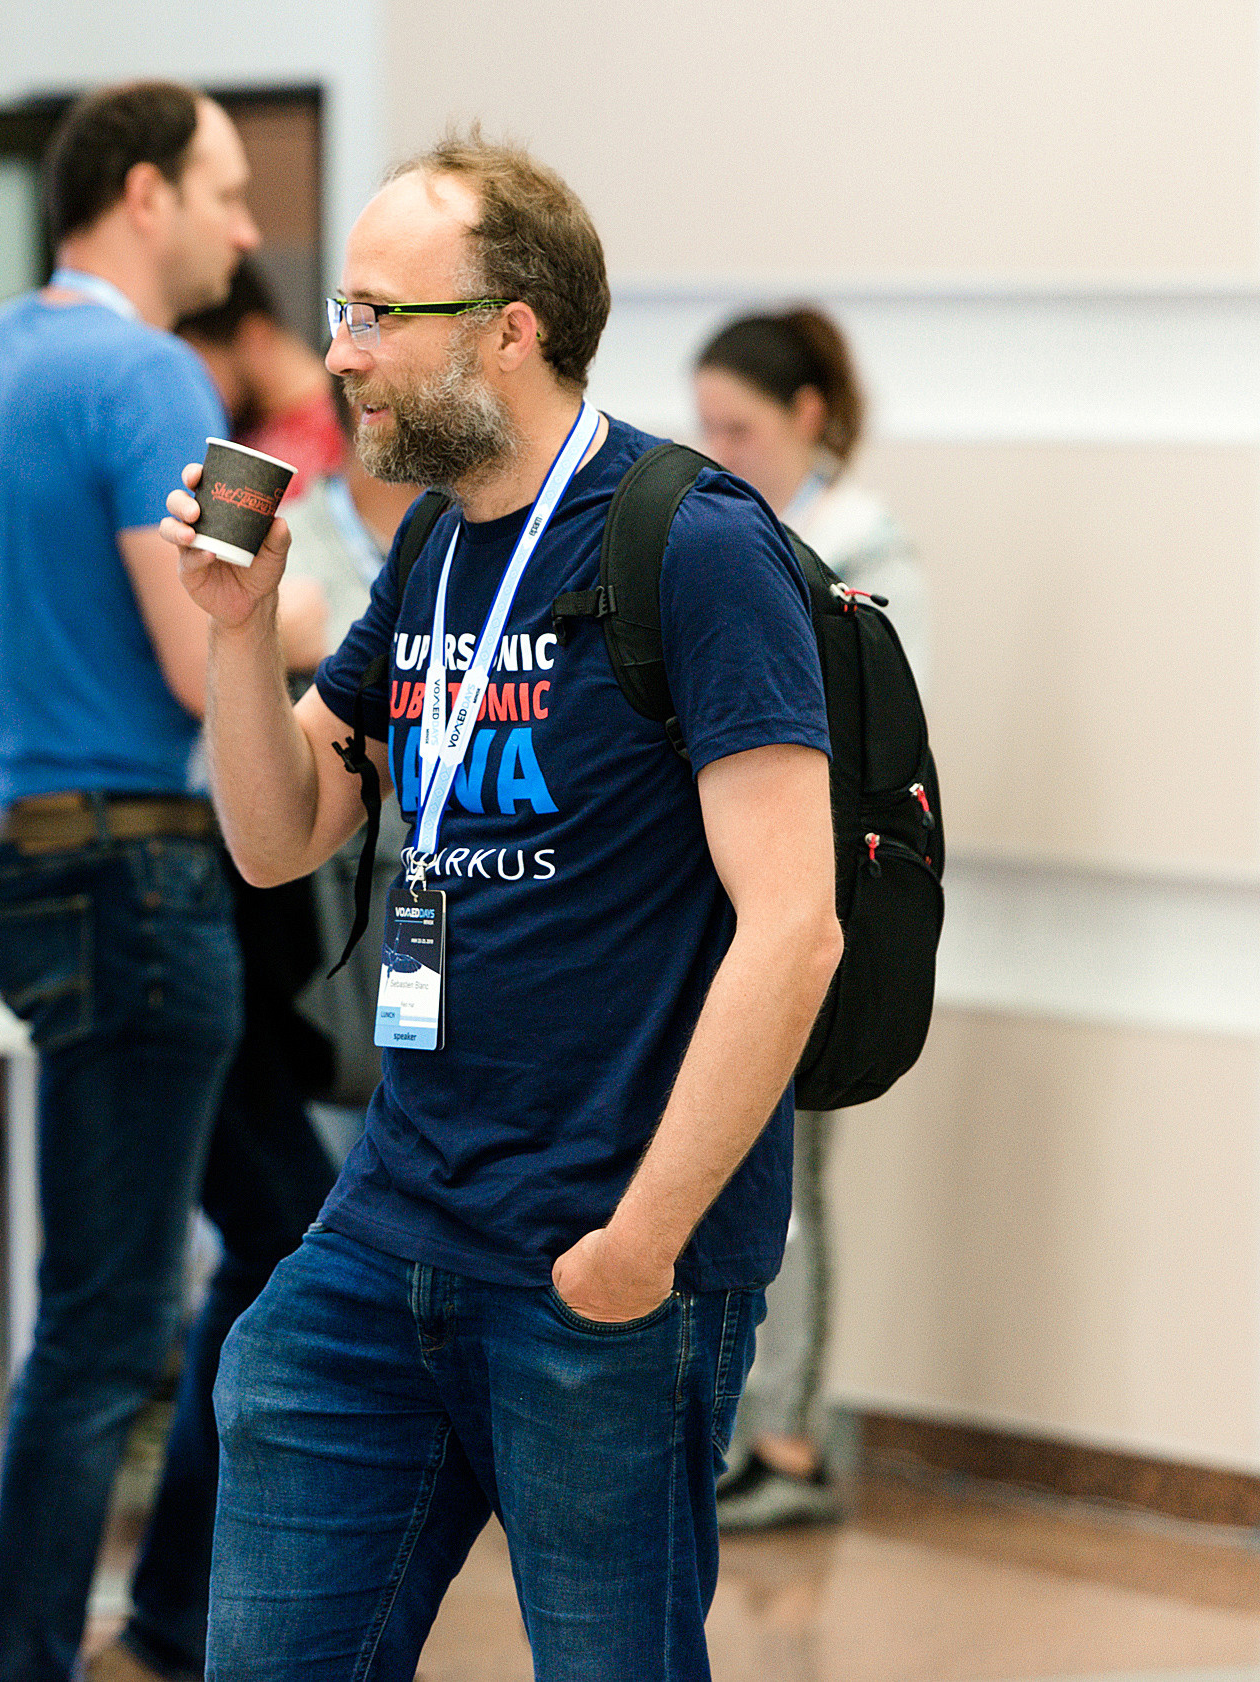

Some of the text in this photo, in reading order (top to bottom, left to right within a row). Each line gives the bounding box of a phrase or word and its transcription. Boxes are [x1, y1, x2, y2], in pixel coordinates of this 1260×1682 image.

[394, 632, 557, 671] UPRSNIC
[390, 680, 551, 721] UBTMIC
[393, 1032, 417, 1041] speaker
